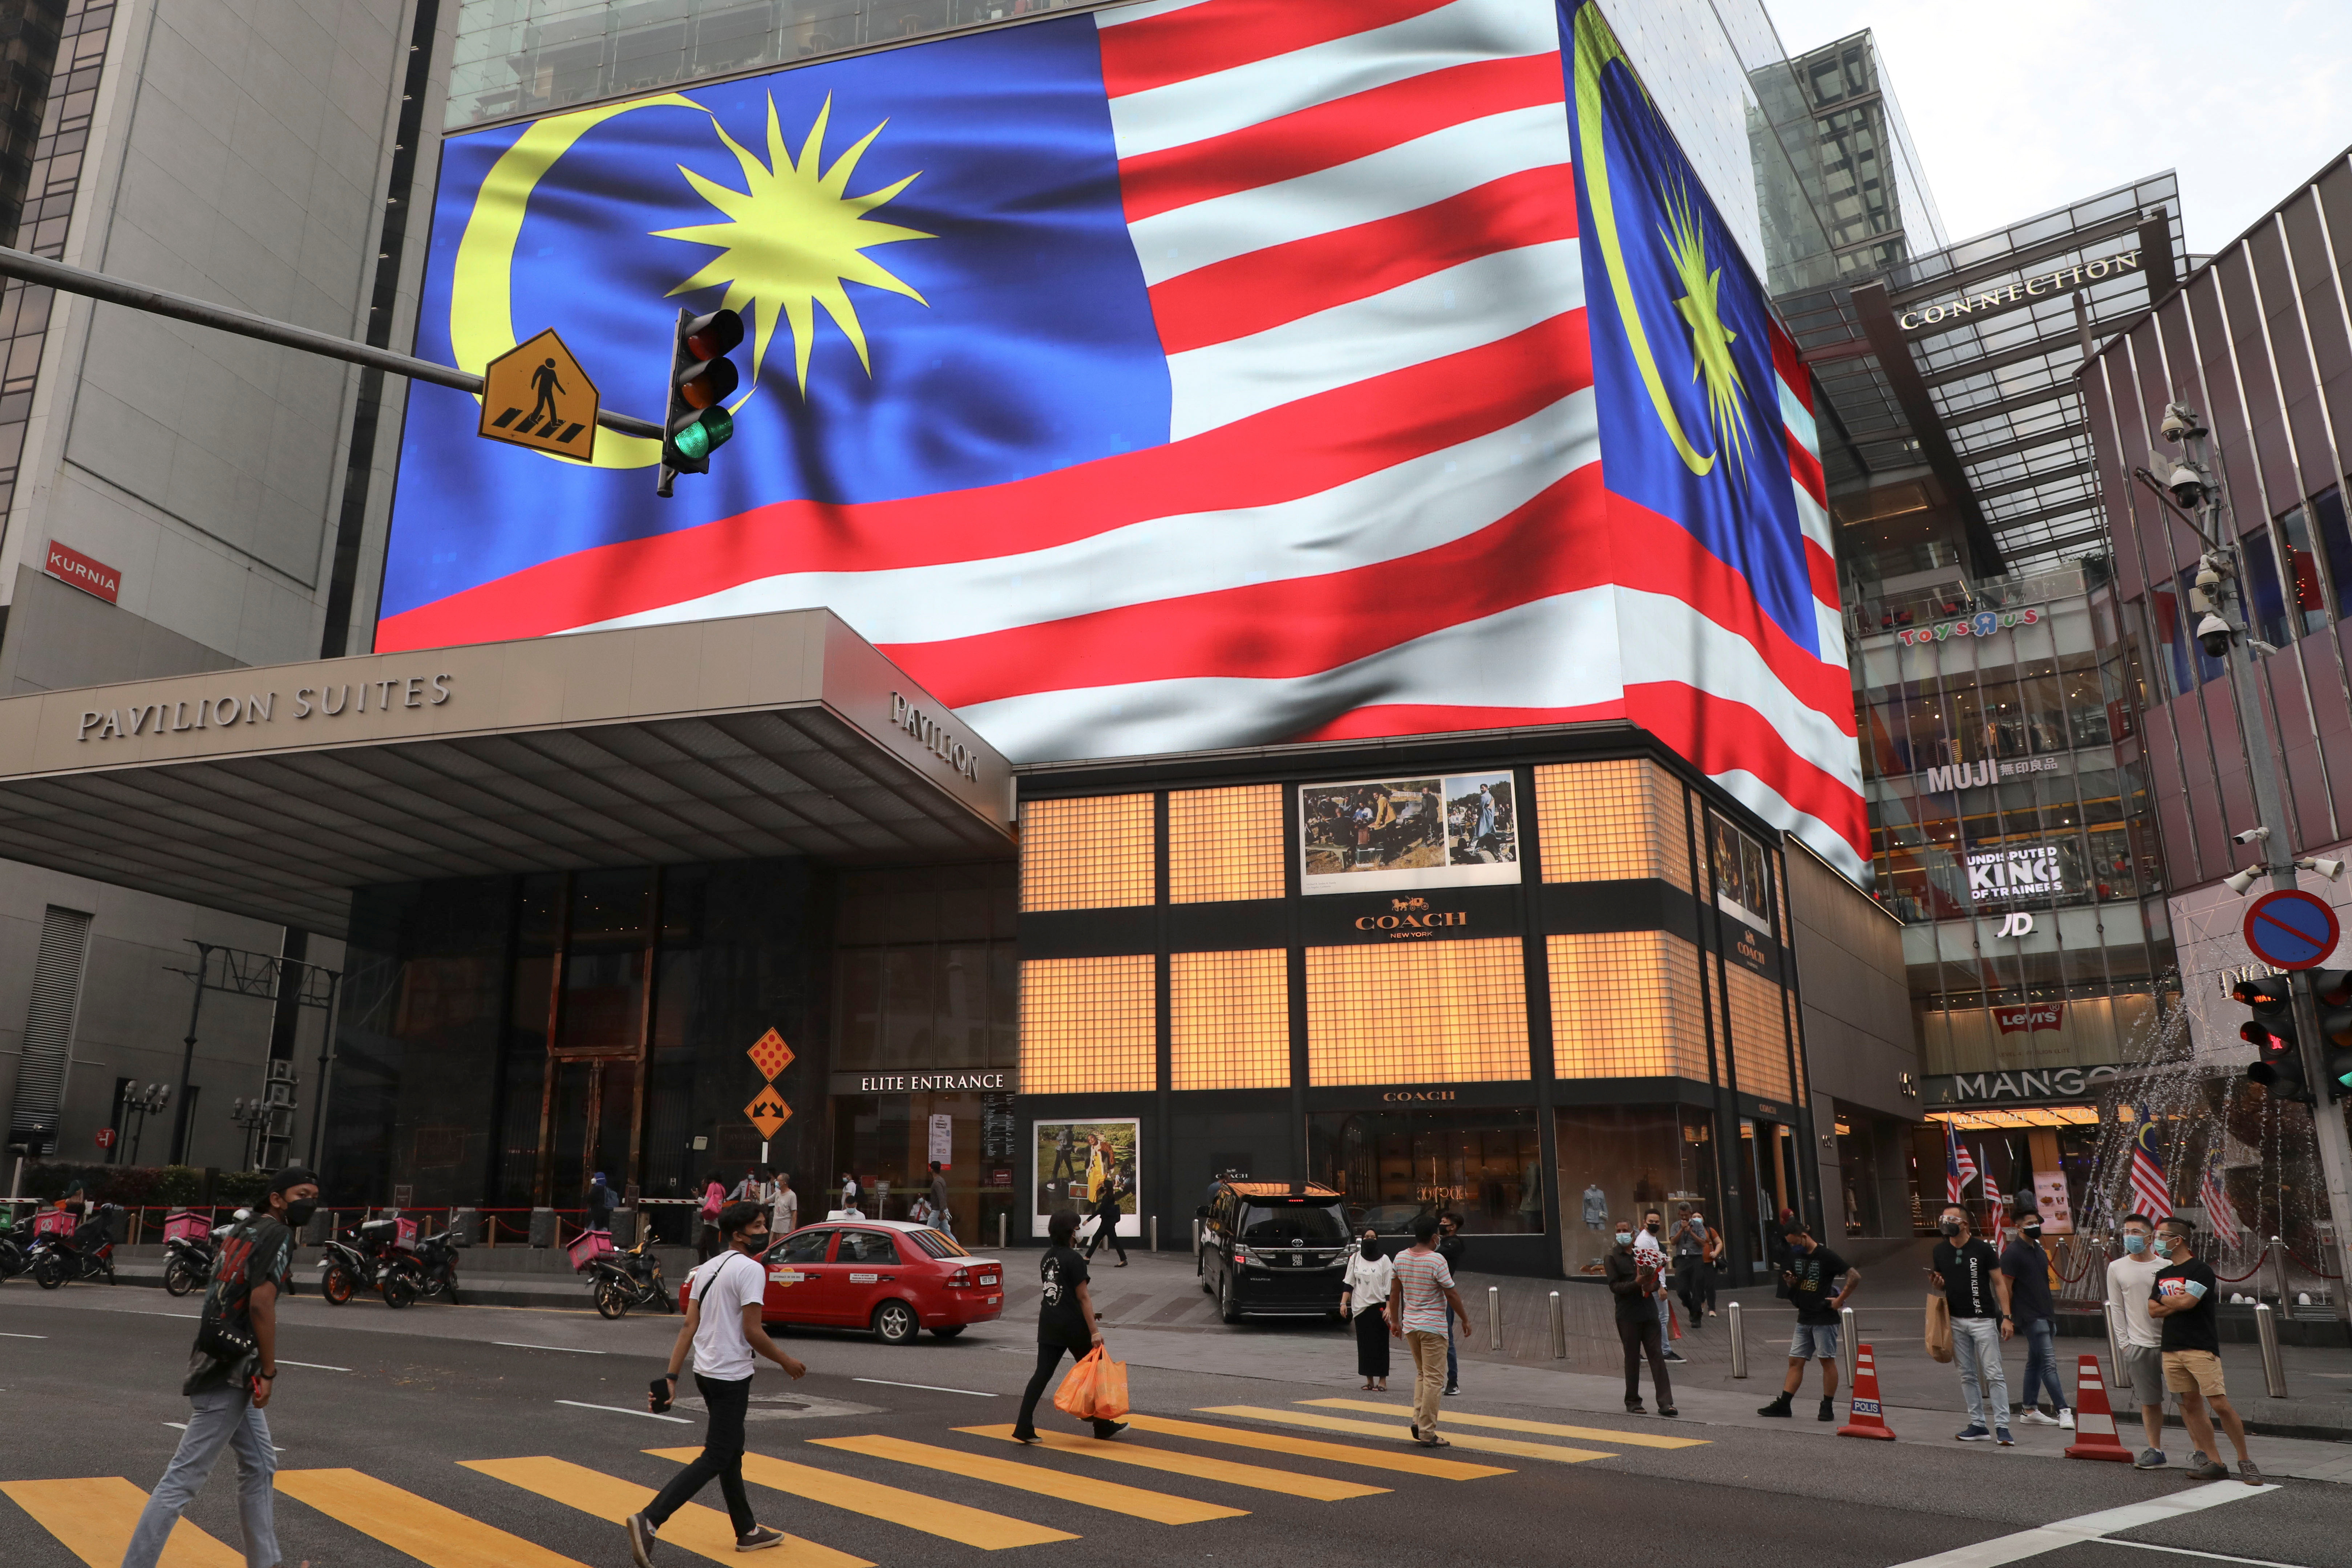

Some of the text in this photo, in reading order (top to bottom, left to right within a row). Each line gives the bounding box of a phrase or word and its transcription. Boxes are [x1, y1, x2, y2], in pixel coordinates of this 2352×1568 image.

[1900, 251, 2137, 330] CONNECTION
[50, 552, 115, 592] KURNIA
[77, 673, 450, 741] PAVILION SUITES
[890, 691, 978, 782] PAVILION
[1927, 758, 1998, 793] MUJI
[2000, 757, 2058, 776] 無印良品
[1967, 847, 2057, 866] UNDISPUTED
[1969, 857, 2061, 890] KING
[1972, 882, 2062, 899] OF TRAINERS
[1355, 912, 1467, 930] COACH
[1997, 912, 2033, 938] JD
[1737, 942, 1765, 965] COACH
[862, 1074, 1004, 1091] ELITE ENTRANCE
[1383, 1091, 1455, 1101] COACH
[1759, 1104, 1777, 1114] COACH
[1957, 1112, 2027, 1124] WELCOME
[2039, 1111, 2057, 1121] TO
[1855, 1402, 1878, 1413] POLIS
